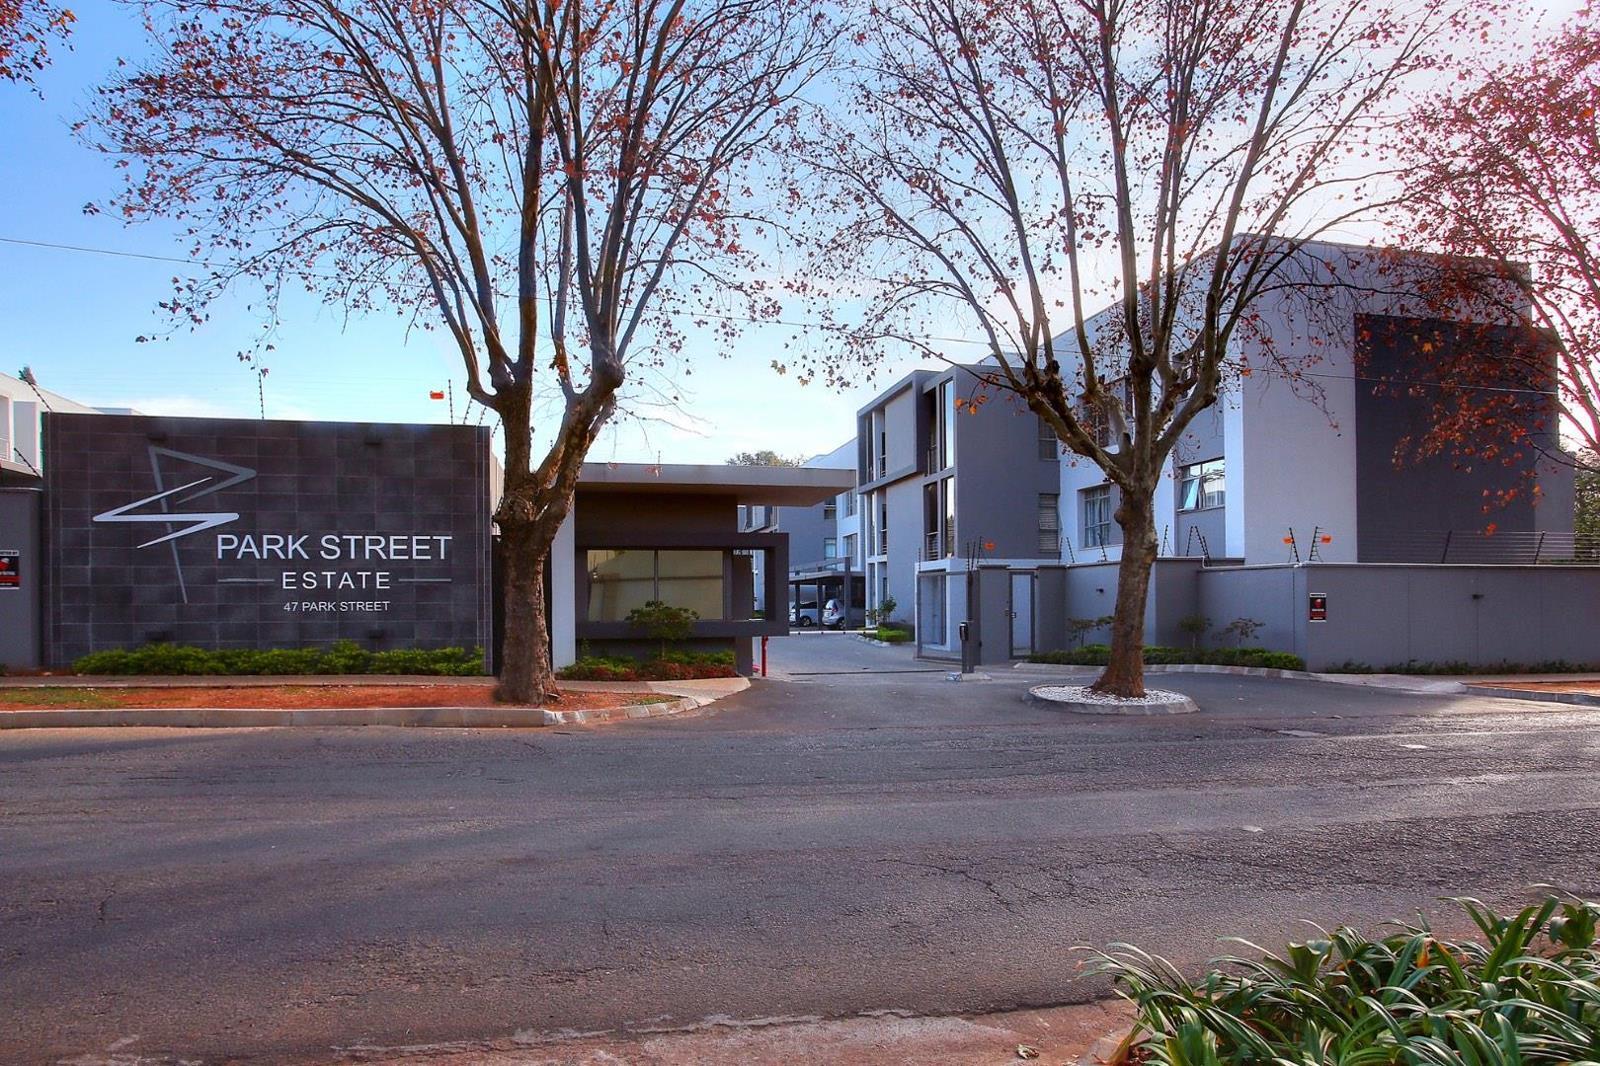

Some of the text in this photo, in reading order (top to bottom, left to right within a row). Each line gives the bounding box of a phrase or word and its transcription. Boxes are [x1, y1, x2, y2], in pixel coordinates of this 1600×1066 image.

[216, 534, 453, 560] PARK STREET
[282, 571, 391, 590] ESTATE
[283, 601, 391, 612] 47 PARK STREET
